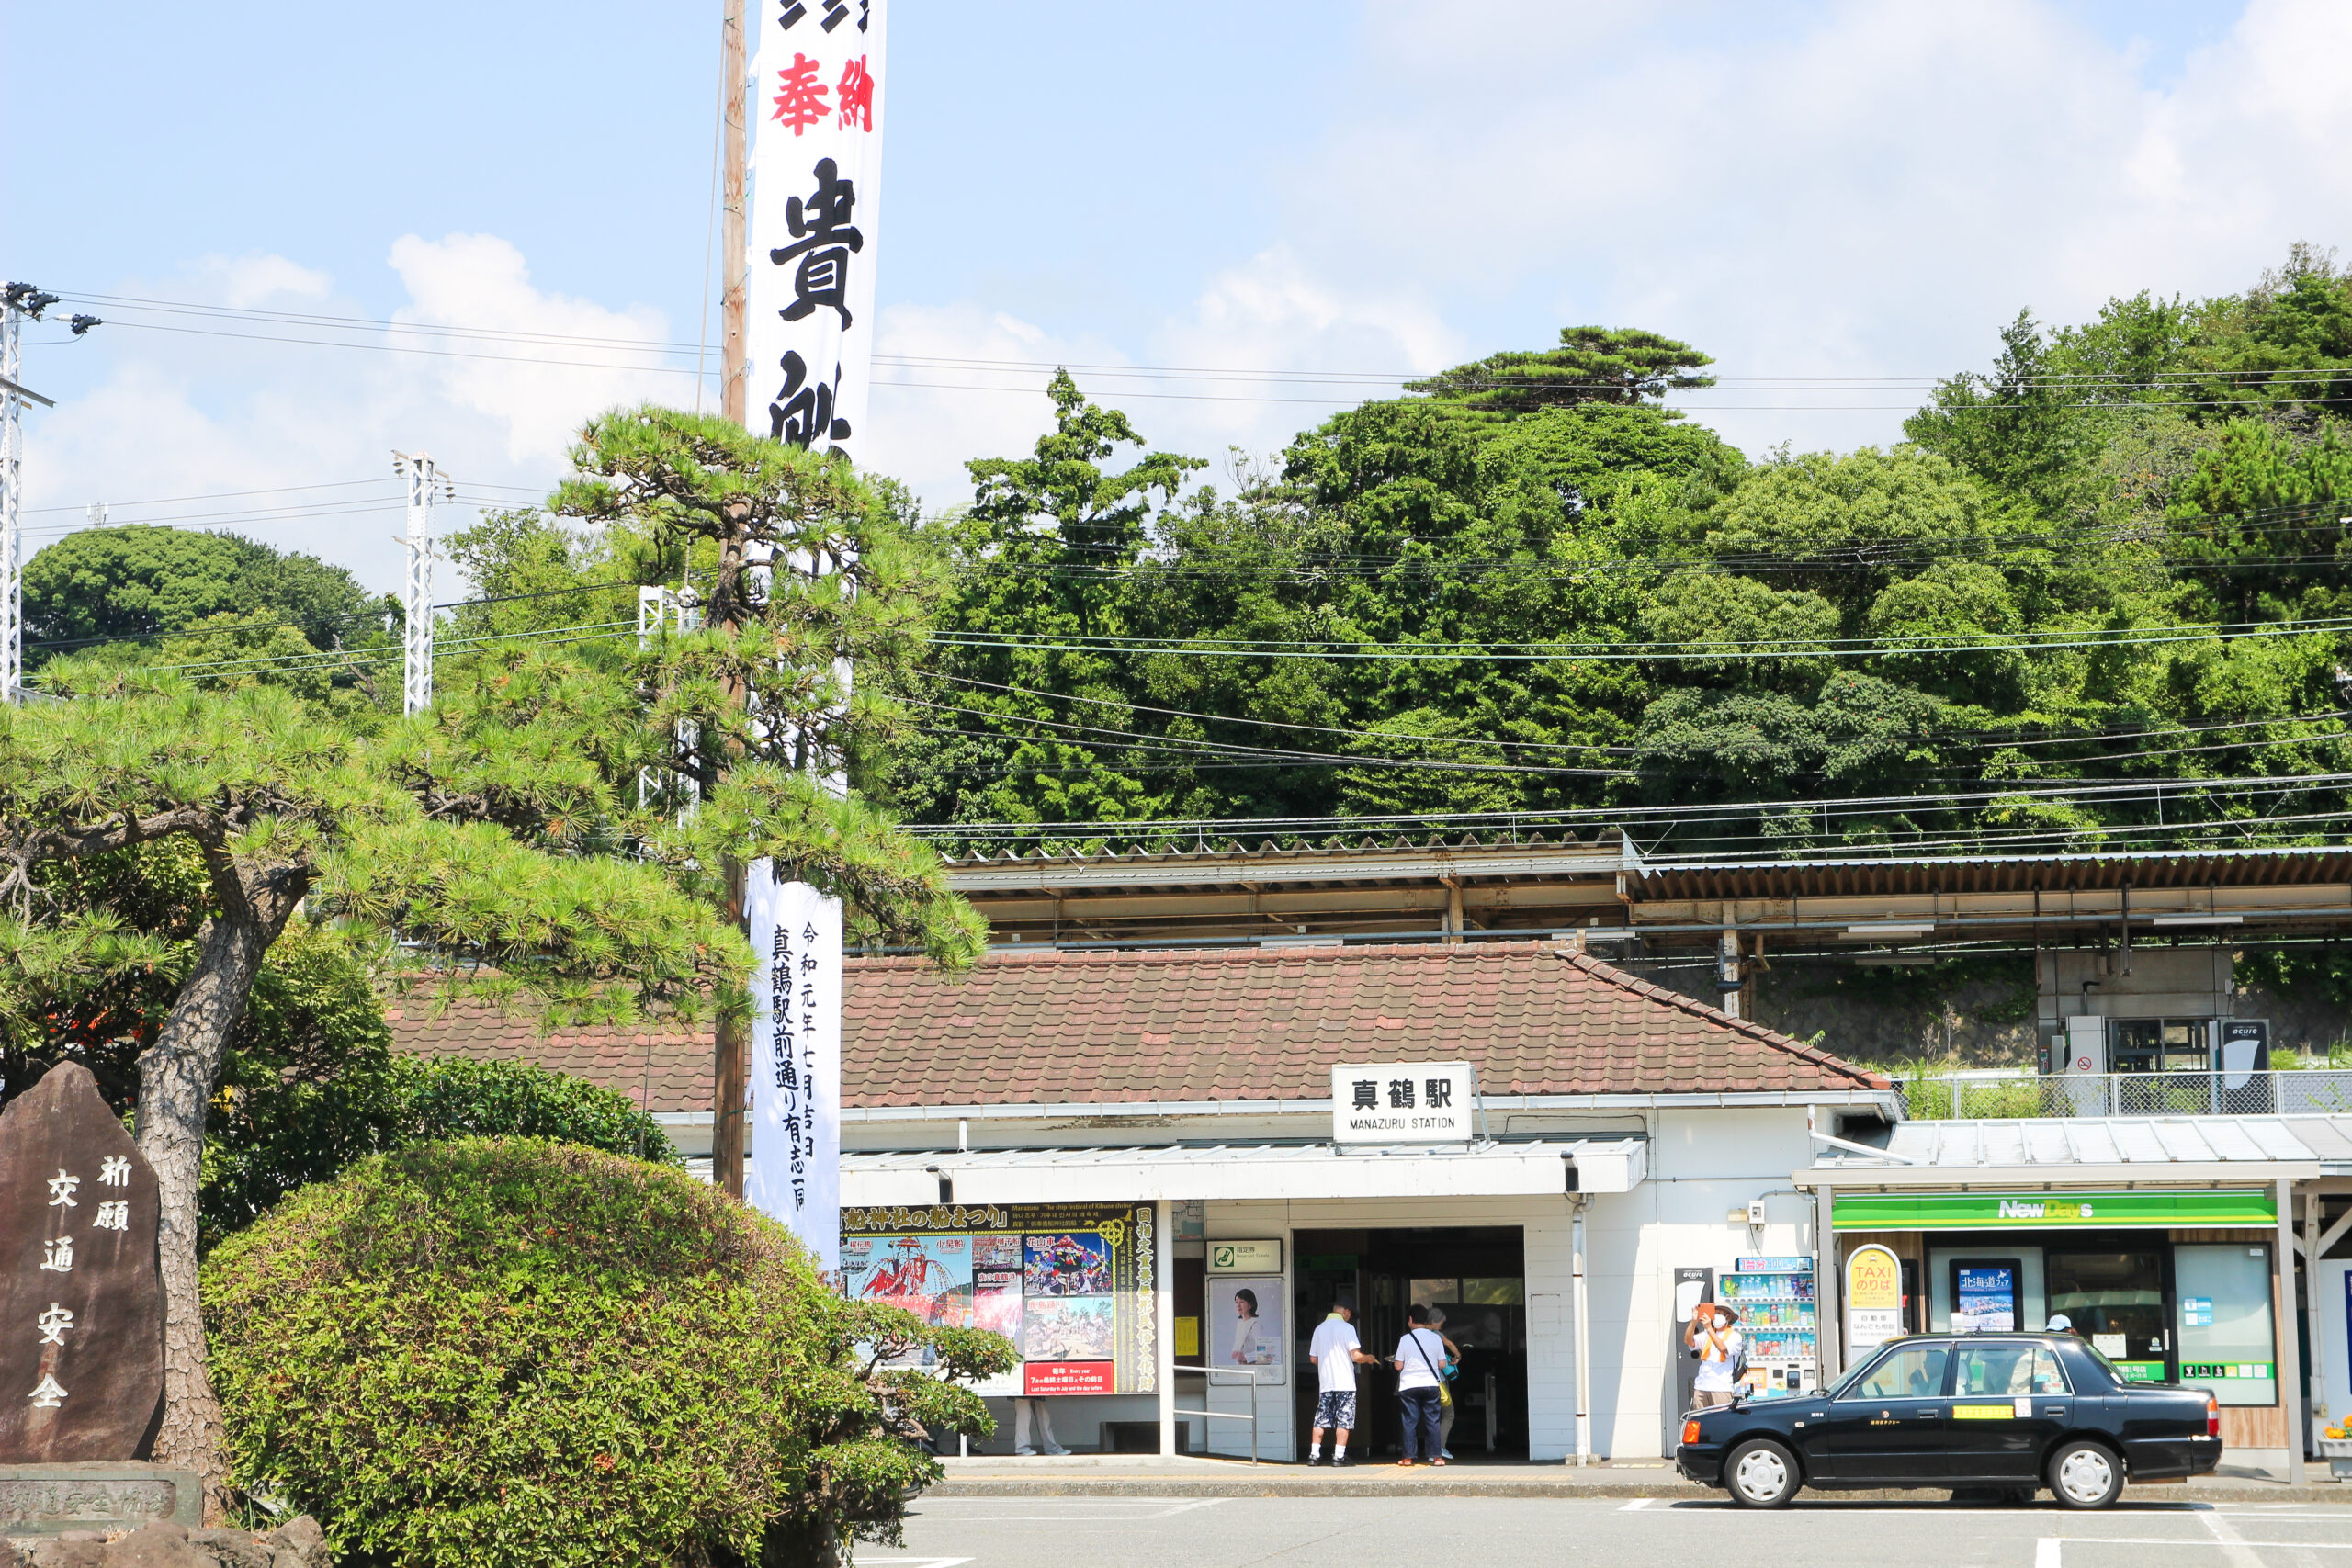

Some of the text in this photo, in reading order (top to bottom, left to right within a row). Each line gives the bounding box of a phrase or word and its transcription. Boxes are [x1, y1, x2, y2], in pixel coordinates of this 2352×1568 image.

[771, 52, 875, 137] 奉納
[800, 920, 819, 1158] 令和元年七月吉日
[771, 924, 805, 1212] 真鶴駅前通り有志一同
[1351, 1078, 1452, 1111] 真鶴駅
[1350, 1117, 1454, 1130] MANAZURU STATION
[93, 1155, 132, 1232] 祈願
[1998, 1199, 2094, 1219] NewDays
[840, 1205, 1008, 1231] 船神社の船まつり」
[28, 1168, 80, 1408] 交通安全
[1855, 1267, 1891, 1278] TAXI
[1857, 1280, 1891, 1291] のりば
[1962, 1276, 2009, 1288] 北海道フェア
[1136, 1207, 1156, 1393] 国指定重要無形民俗文化財
[0, 1483, 165, 1515] 交通安全協会
